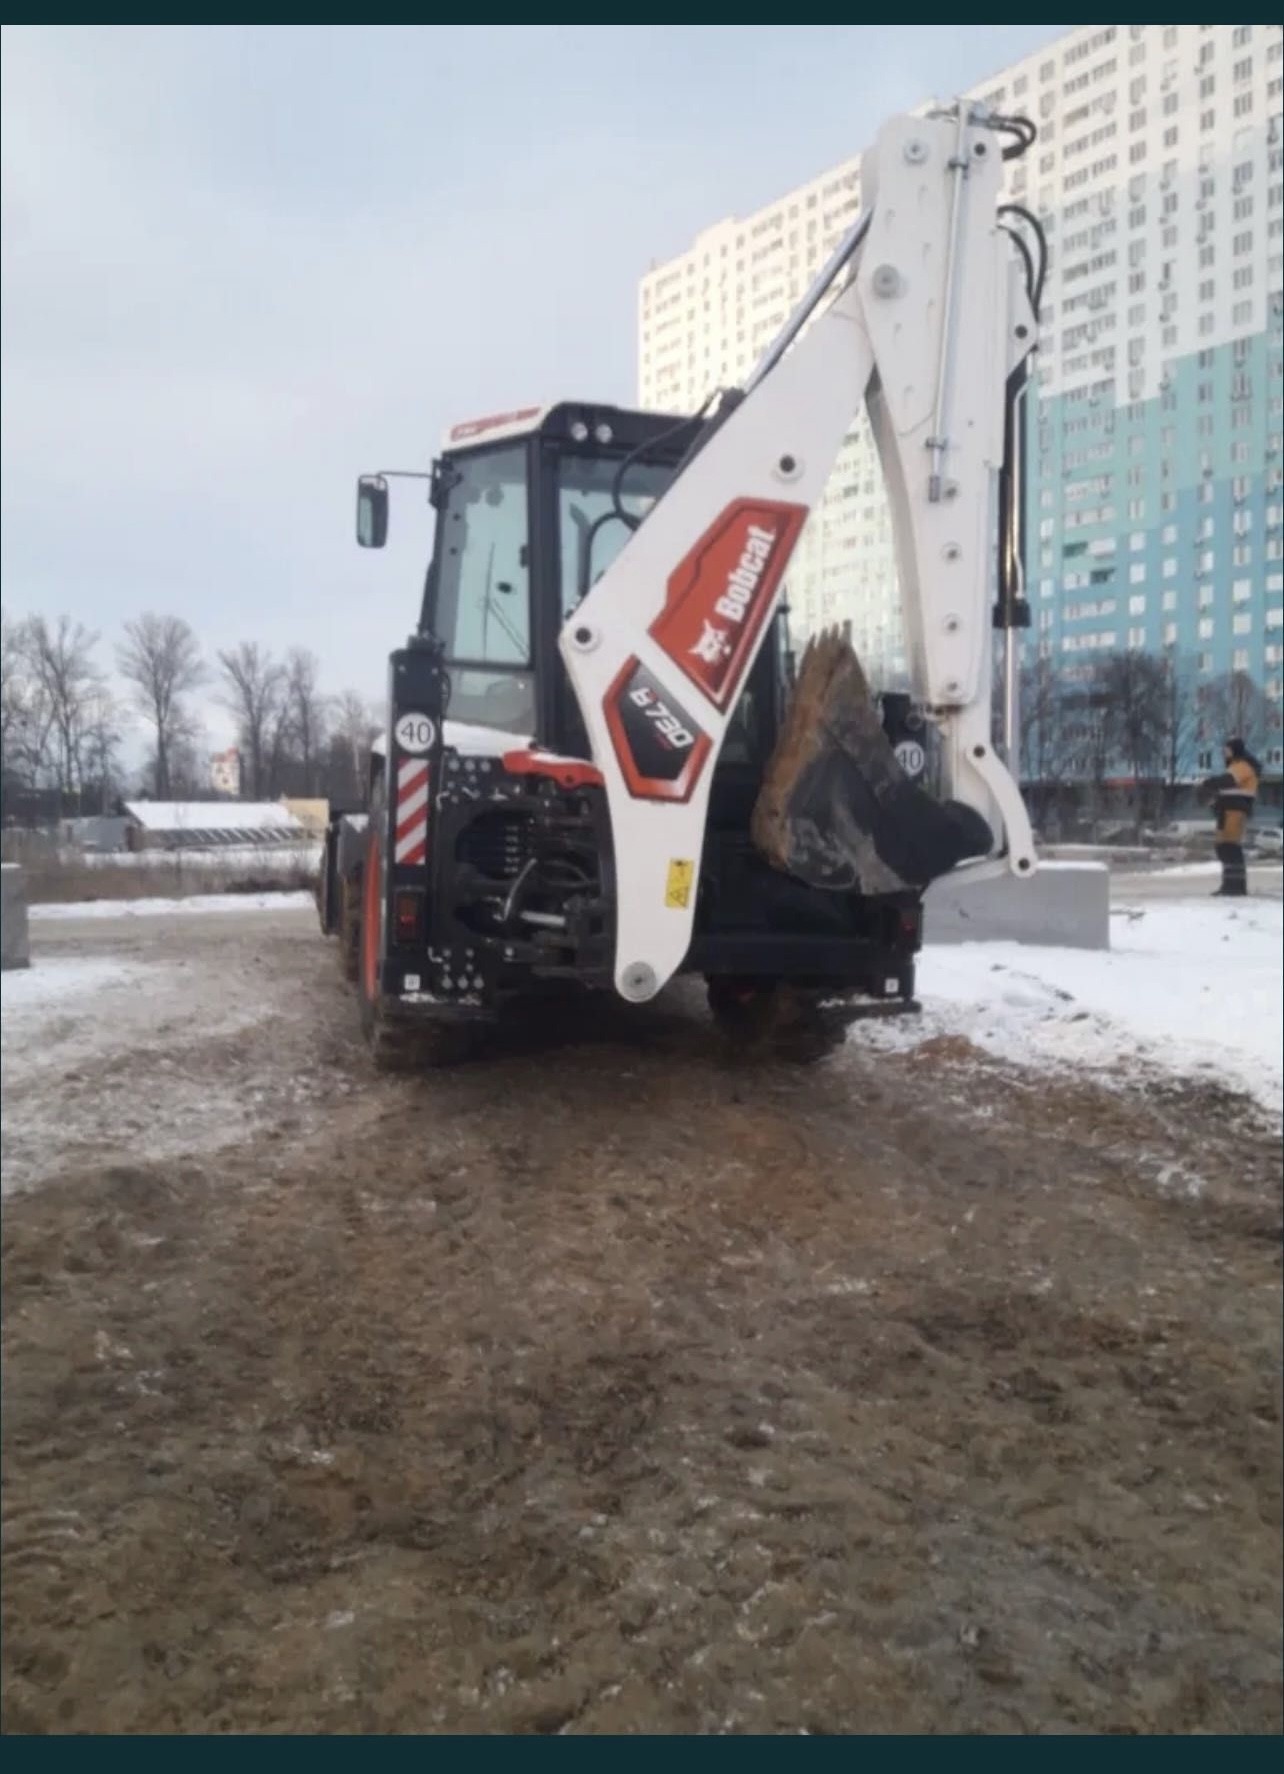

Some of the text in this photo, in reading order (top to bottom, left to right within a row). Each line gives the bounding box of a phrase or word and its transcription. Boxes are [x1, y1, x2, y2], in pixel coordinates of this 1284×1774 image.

[714, 525, 775, 622] Bobcat
[400, 721, 431, 744] 40
[630, 687, 694, 748] B730
